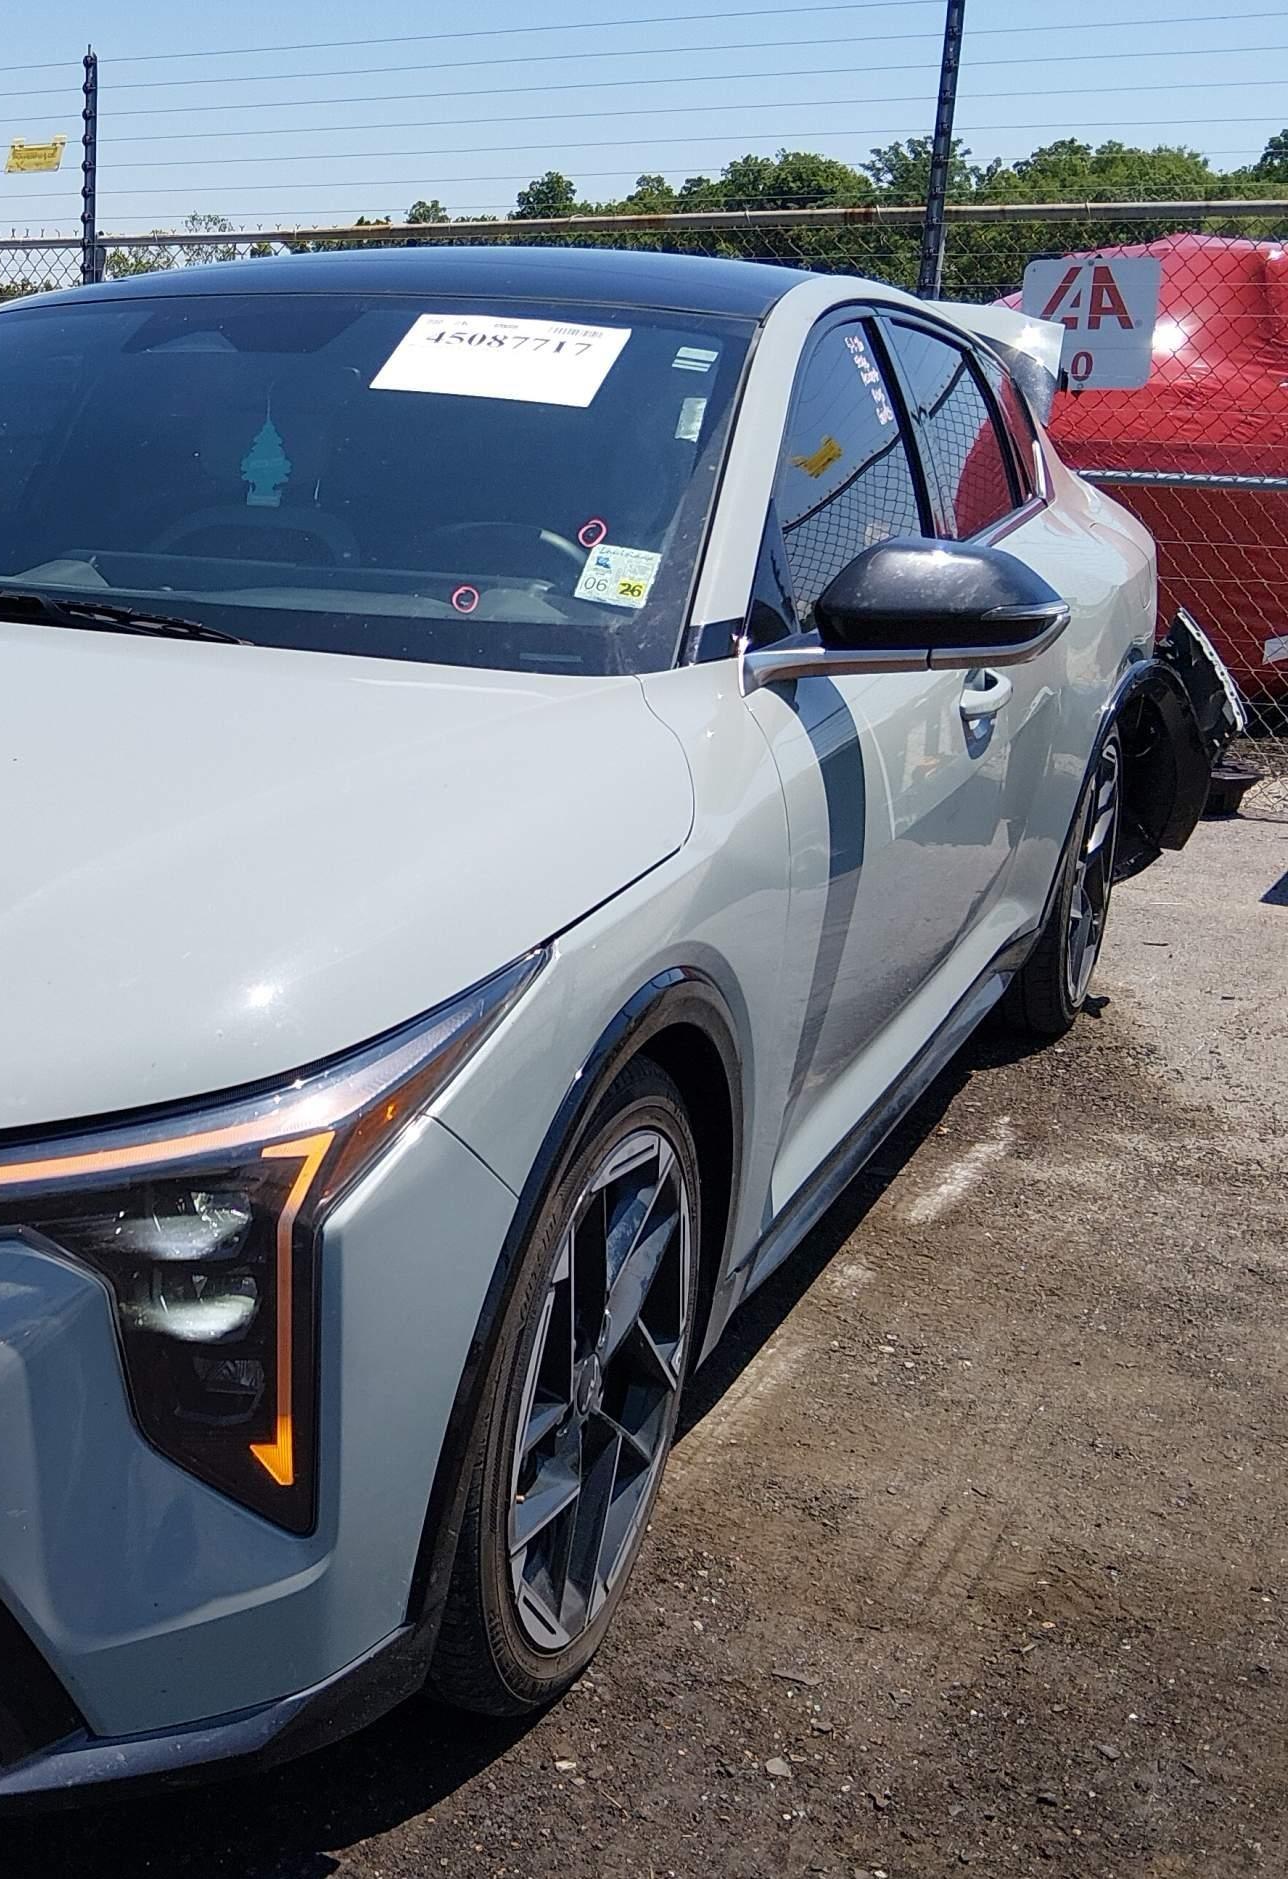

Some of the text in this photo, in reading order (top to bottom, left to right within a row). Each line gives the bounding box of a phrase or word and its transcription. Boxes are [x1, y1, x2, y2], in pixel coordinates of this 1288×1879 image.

[425, 331, 592, 356] 45087717
[584, 576, 609, 592] 06
[619, 582, 643, 598] 26
